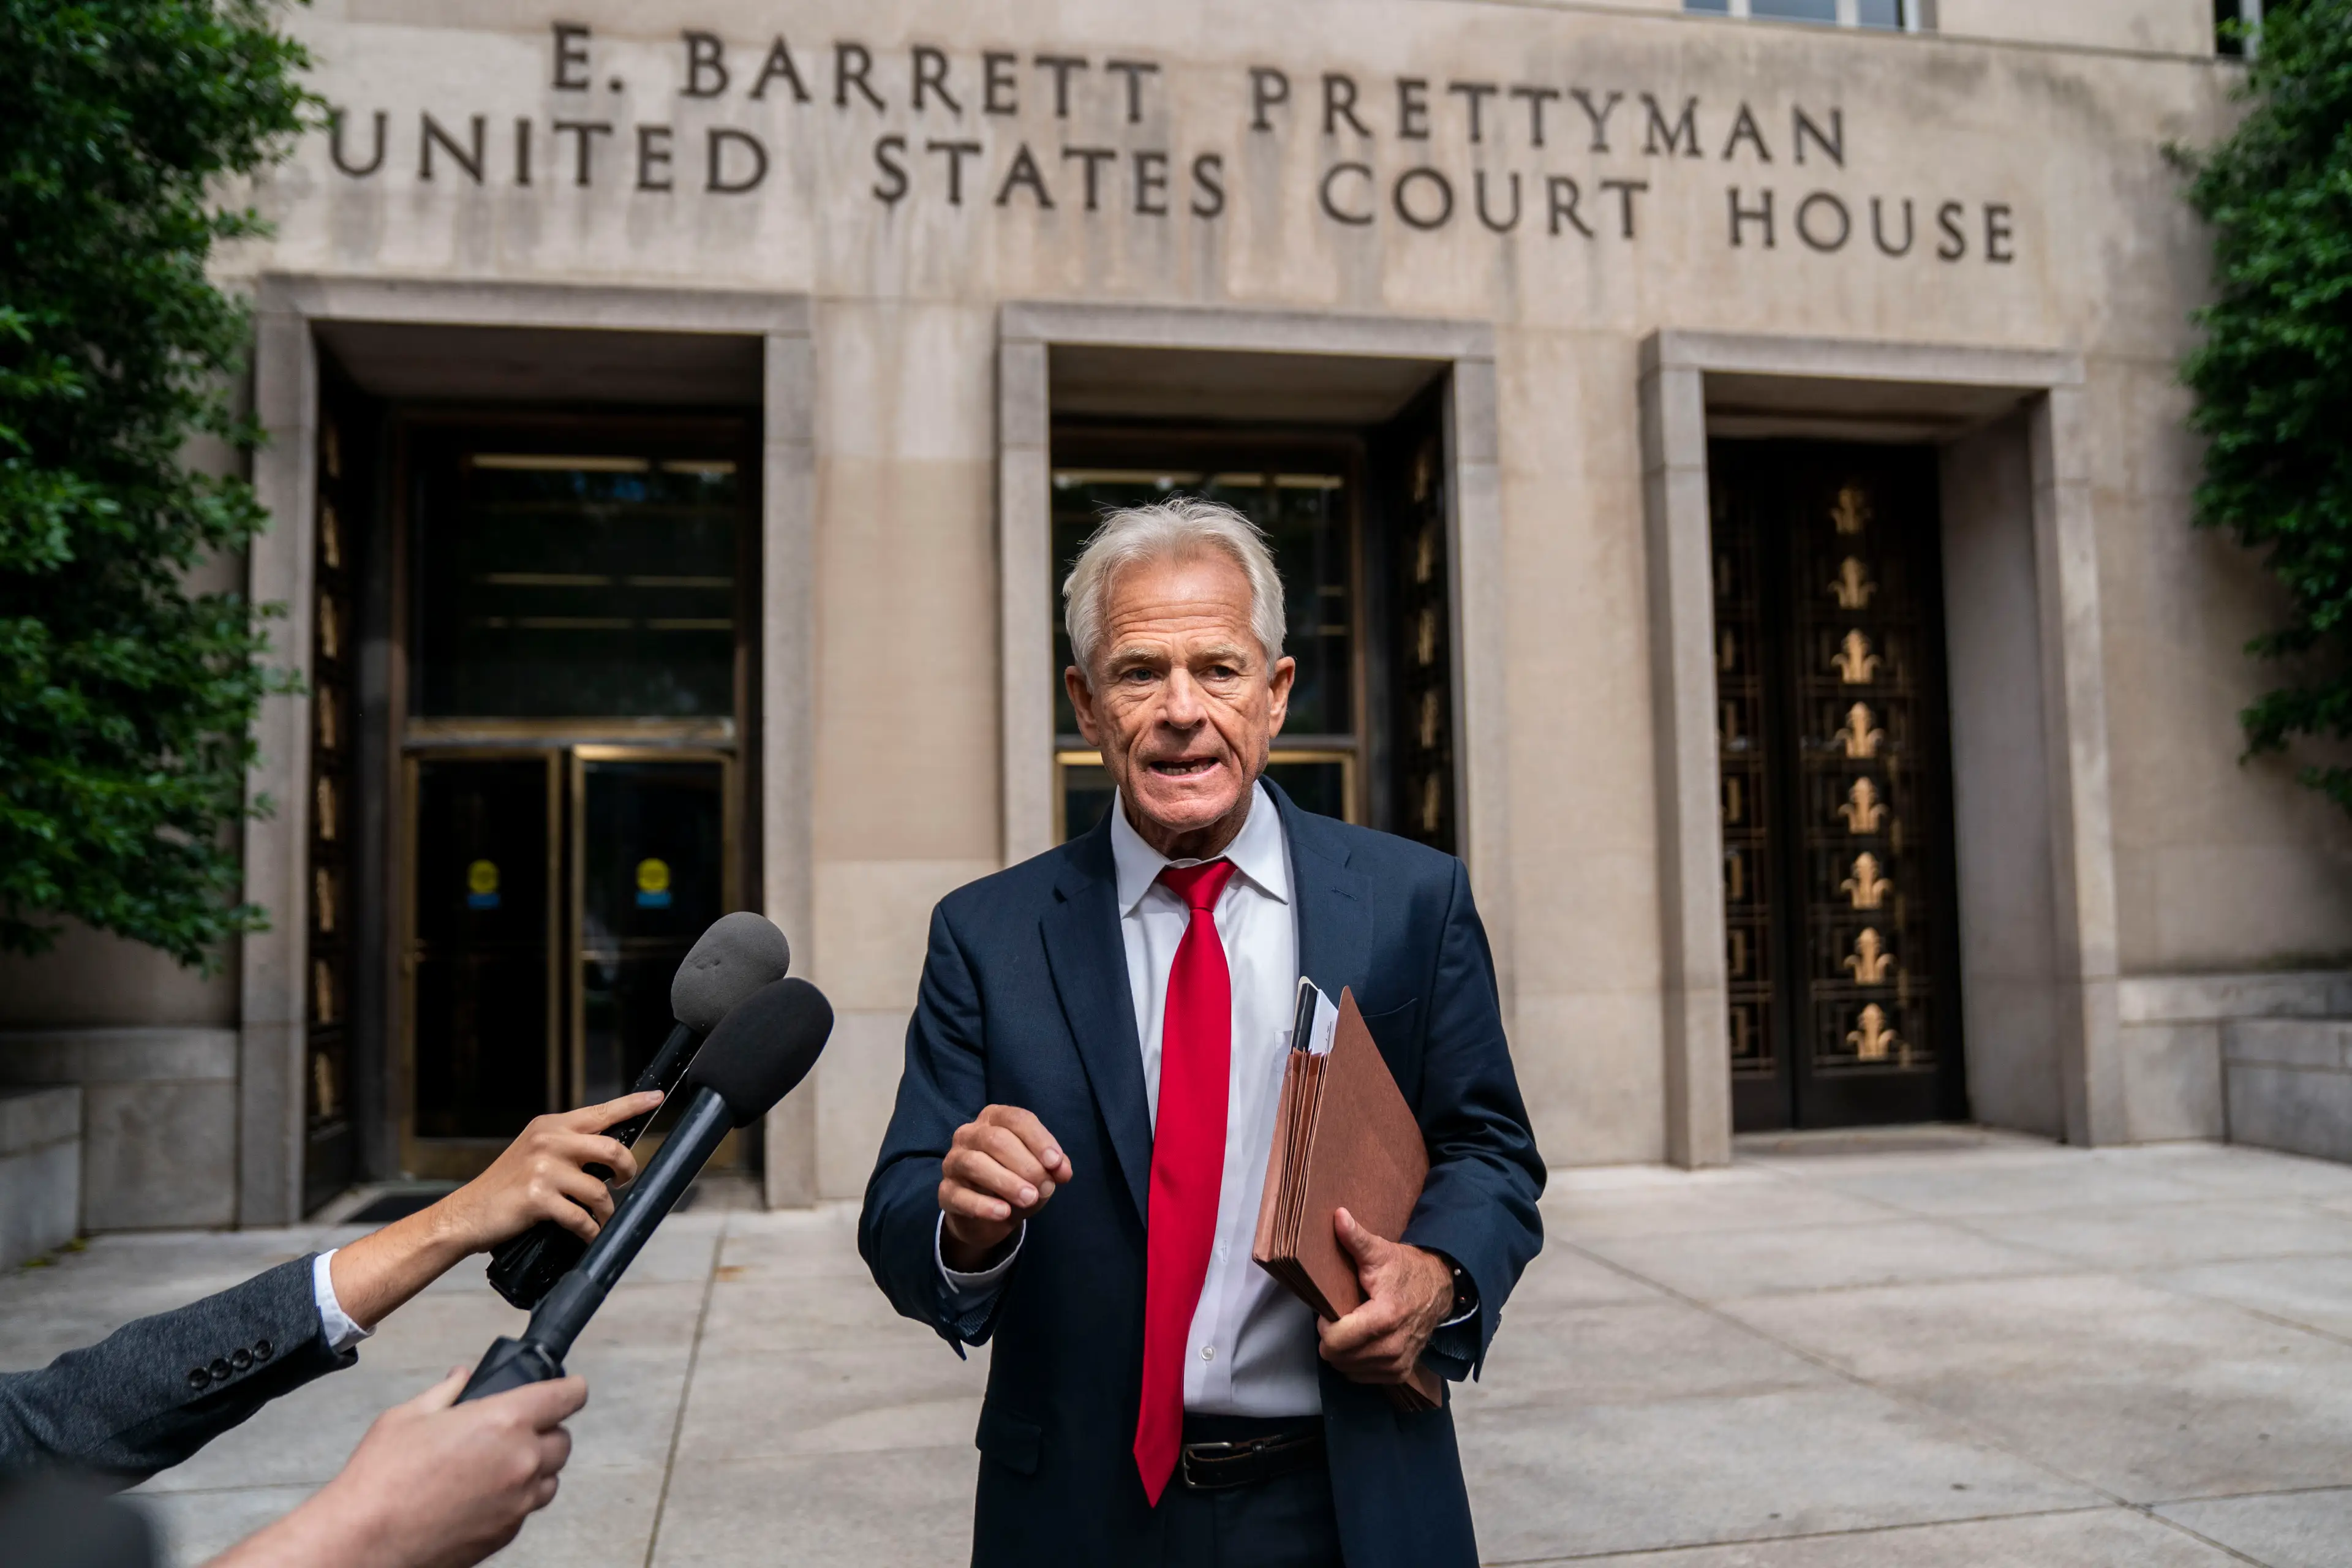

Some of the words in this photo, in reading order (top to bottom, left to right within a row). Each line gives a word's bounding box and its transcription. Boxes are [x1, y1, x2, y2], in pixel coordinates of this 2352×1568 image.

[551, 23, 624, 91] E.
[680, 30, 1160, 123] BARRETT
[1249, 67, 1846, 168] PRETTYMAN
[329, 109, 769, 194] UNITED
[872, 135, 1225, 219] STATES
[1319, 163, 1649, 239] COURT
[1727, 186, 2015, 264] HOUSE
